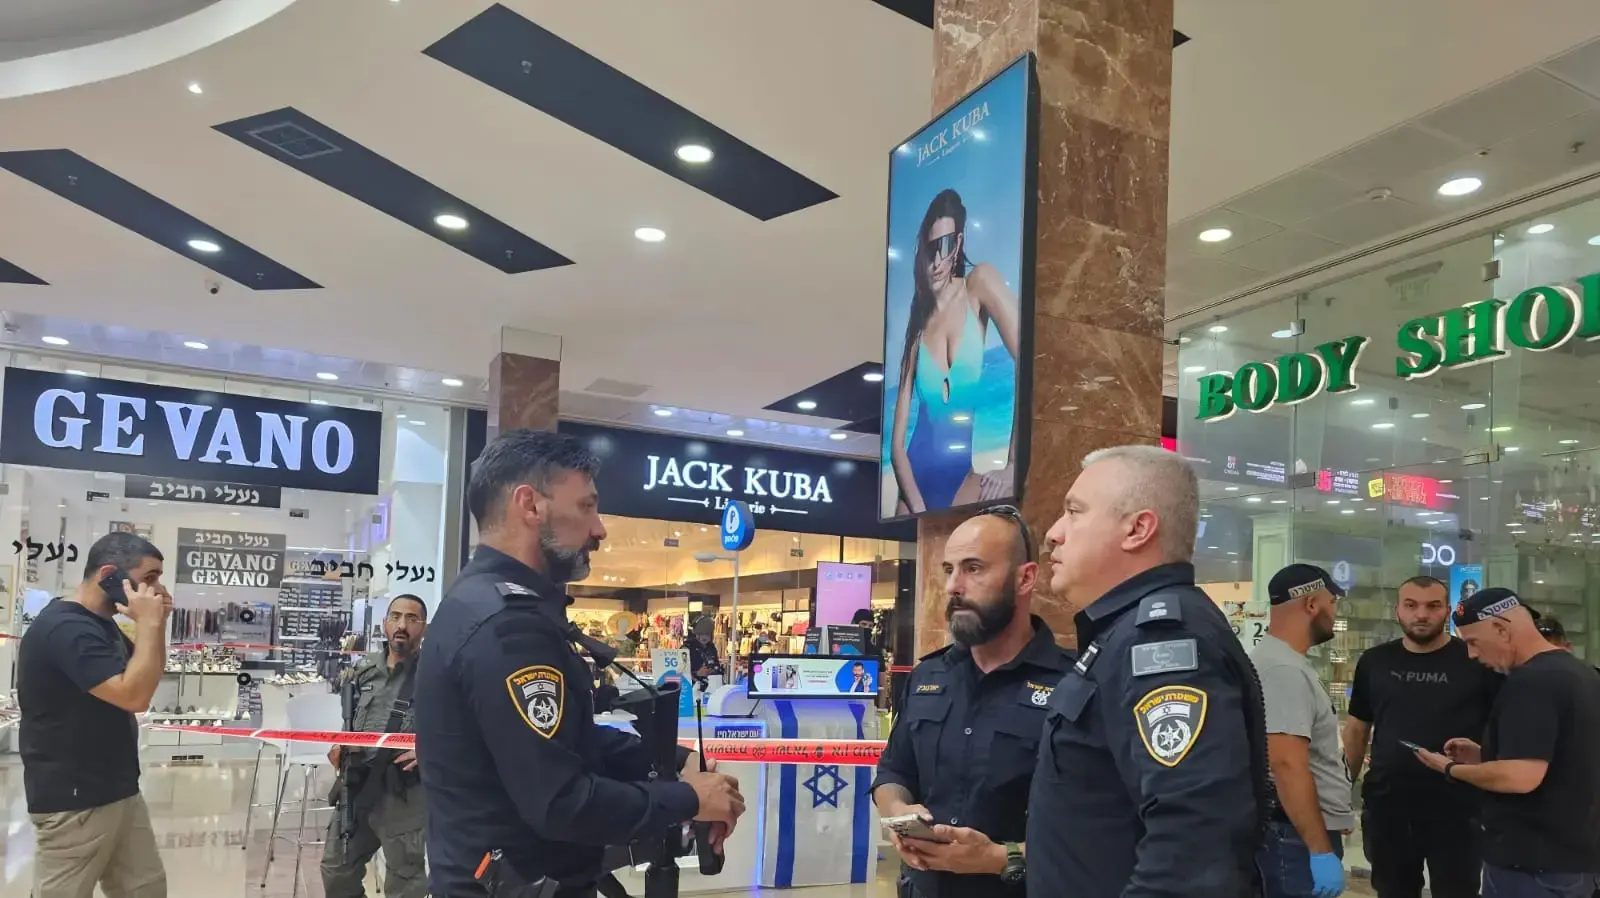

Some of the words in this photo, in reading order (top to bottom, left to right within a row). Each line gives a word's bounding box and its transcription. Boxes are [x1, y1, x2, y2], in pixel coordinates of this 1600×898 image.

[916, 128, 948, 168] JACK
[952, 101, 990, 140] KUBA
[1195, 335, 1371, 423] BODY
[34, 388, 355, 475] GEVANO
[643, 455, 733, 492] JACK
[744, 467, 833, 503] KUBA
[149, 481, 206, 500] חביב
[214, 484, 260, 504] נעלי
[715, 496, 766, 514] Lirie
[195, 531, 233, 545] חביב
[238, 532, 270, 547] נעלי
[12, 535, 78, 563] נעלי
[186, 551, 276, 572] GEVANO
[311, 558, 374, 579] חביב
[385, 559, 435, 583] נעלי
[191, 569, 269, 587] GEVANO
[1291, 579, 1323, 598] משטרה
[664, 657, 679, 668] 5G
[1406, 671, 1448, 684] PUMA
[705, 744, 748, 756] משטרת
[771, 744, 809, 758] ישראל
[831, 744, 849, 758] אין
[852, 746, 885, 758] מעב
